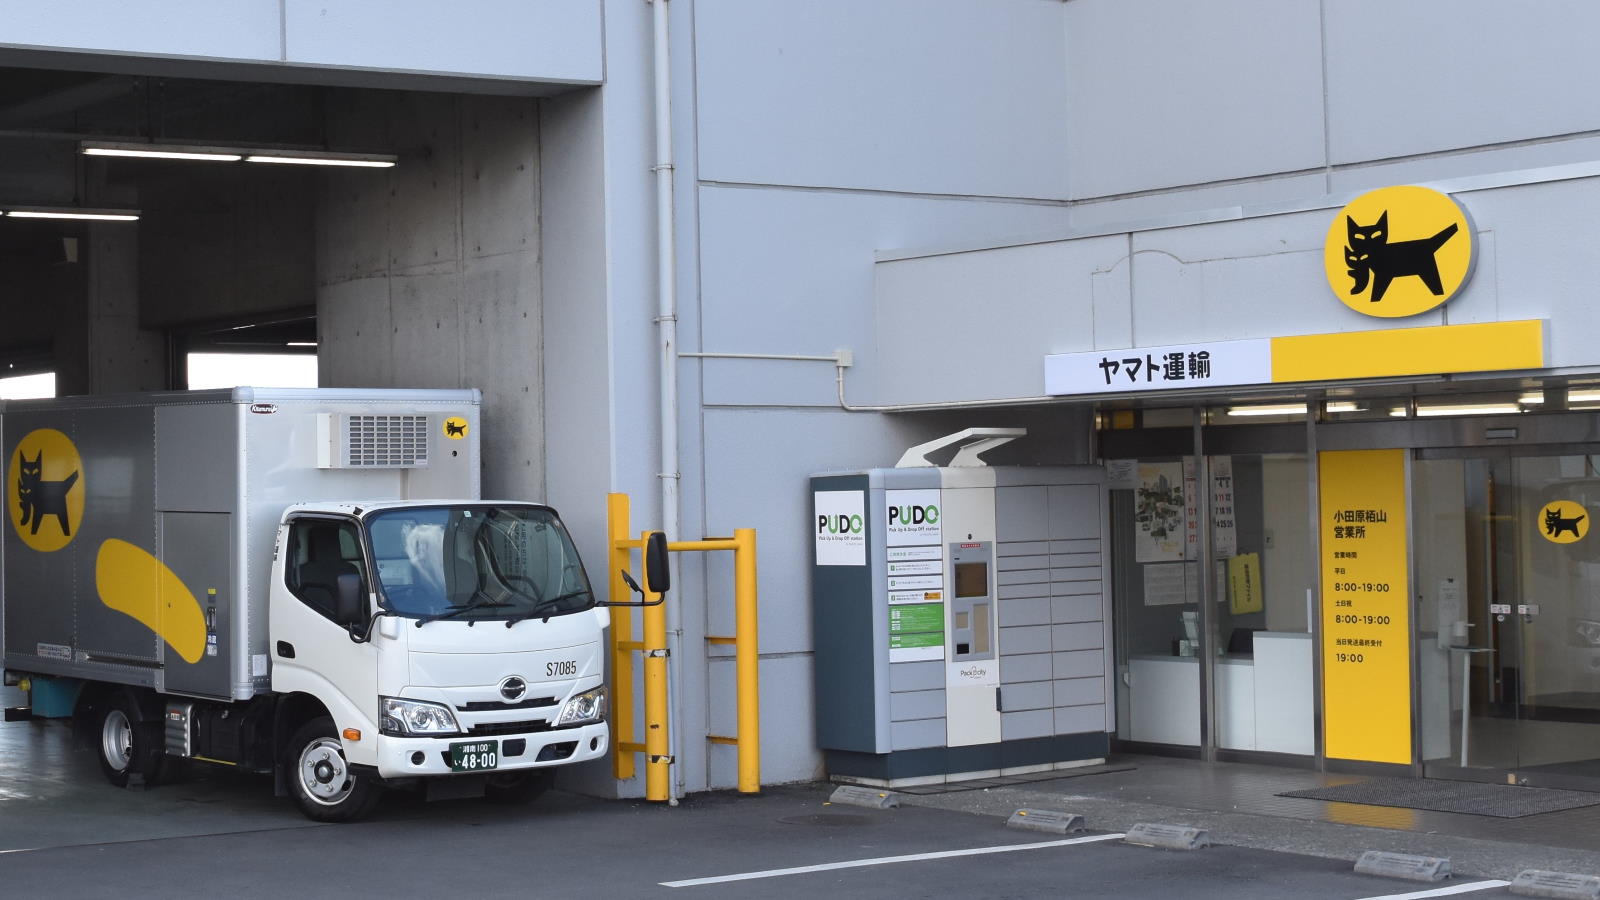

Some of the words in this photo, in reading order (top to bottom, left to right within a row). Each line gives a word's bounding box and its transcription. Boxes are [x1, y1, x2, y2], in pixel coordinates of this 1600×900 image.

[1099, 351, 1211, 385] ヤマト運輸
[889, 505, 939, 525] PUDO
[1334, 509, 1387, 523] 小田原栢山
[819, 514, 863, 534] PUDO
[1334, 526, 1366, 539] 営業所
[1334, 551, 1357, 559] 営業時間
[1335, 582, 1390, 592] 8:00-19:00
[1335, 615, 1390, 625] 8:00-19:00
[1336, 639, 1382, 647] 当日発送最終受付
[1336, 653, 1364, 663] 19:00
[546, 661, 577, 676] S7085
[477, 744, 488, 752] 100
[462, 752, 496, 769] 48-00
